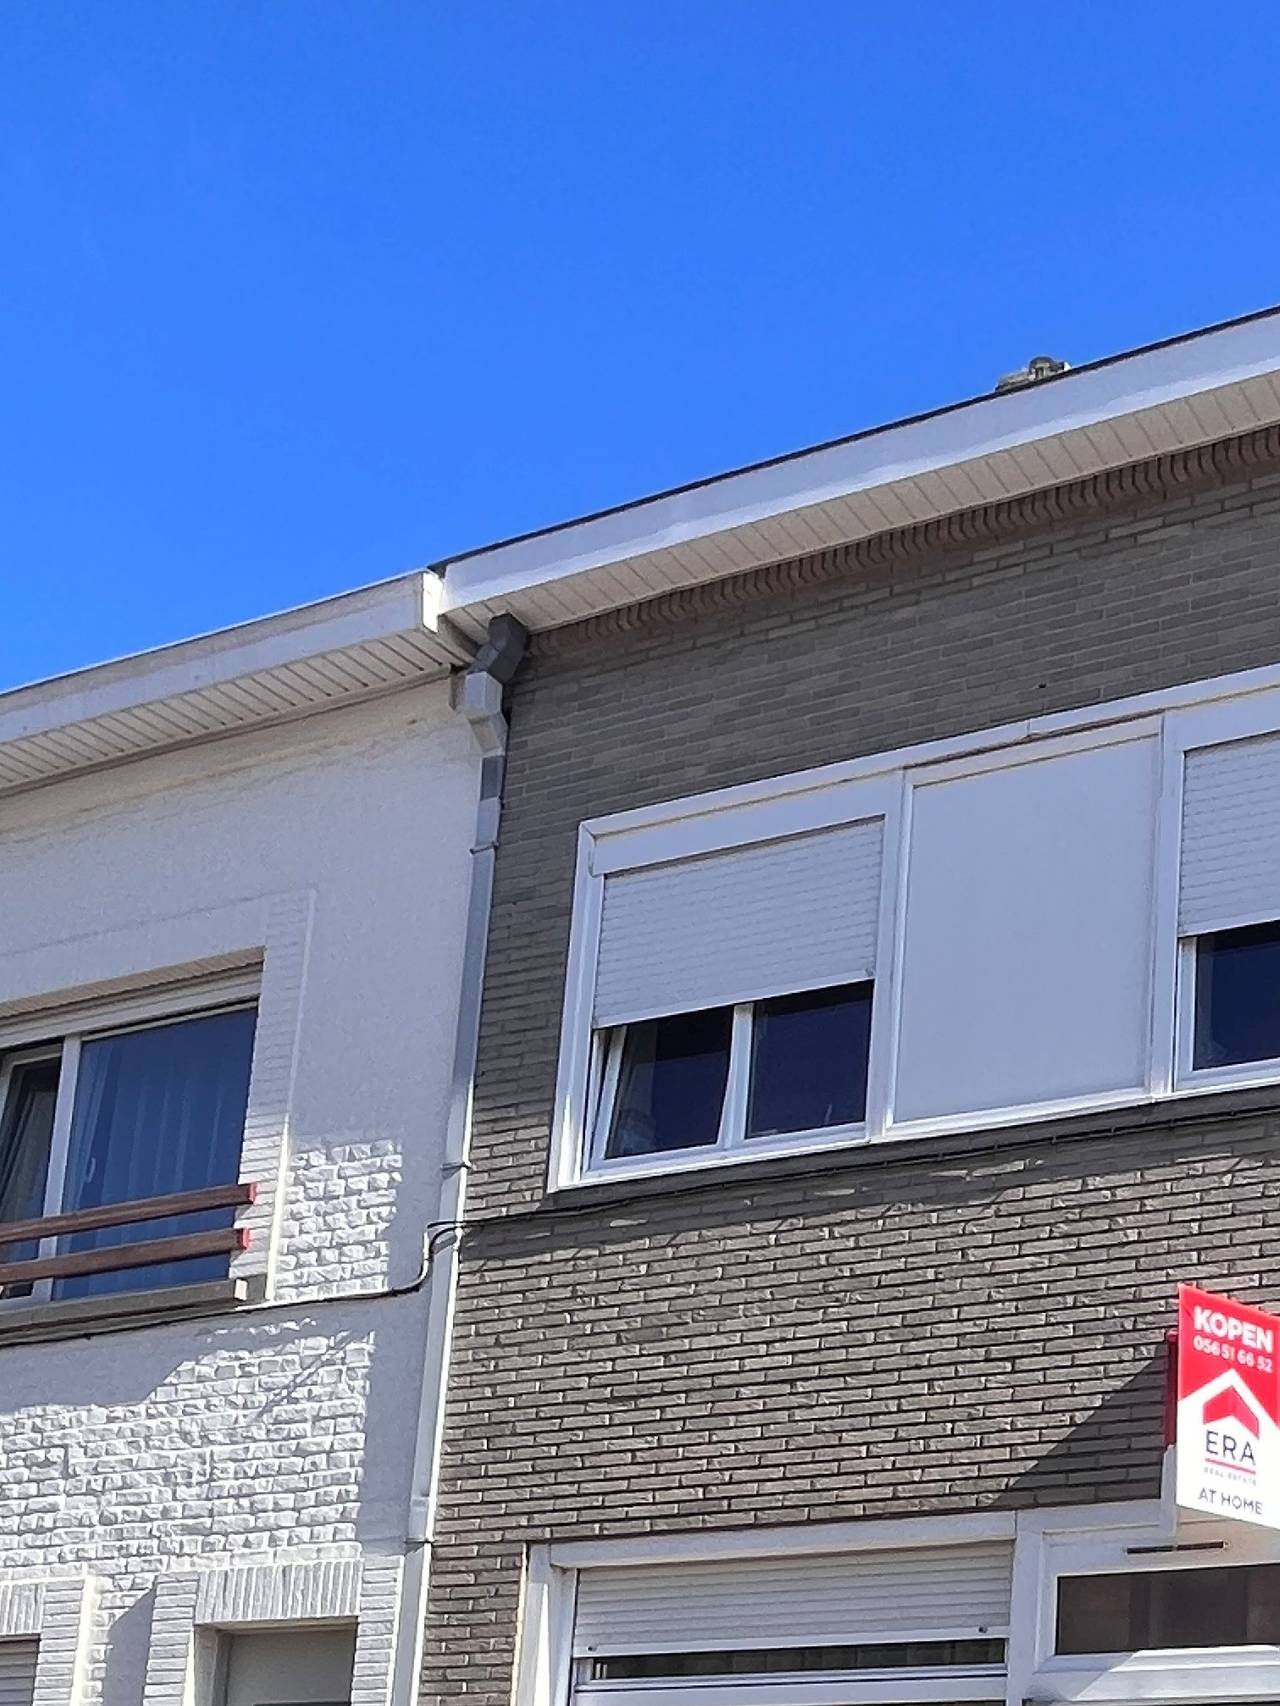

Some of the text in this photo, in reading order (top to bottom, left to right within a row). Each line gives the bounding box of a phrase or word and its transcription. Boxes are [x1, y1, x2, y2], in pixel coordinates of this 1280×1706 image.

[1193, 1305, 1274, 1354] KOPEN
[1193, 1335, 1221, 1356] 056
[1206, 1430, 1256, 1466] ERA
[1198, 1487, 1262, 1515] AT HOME
